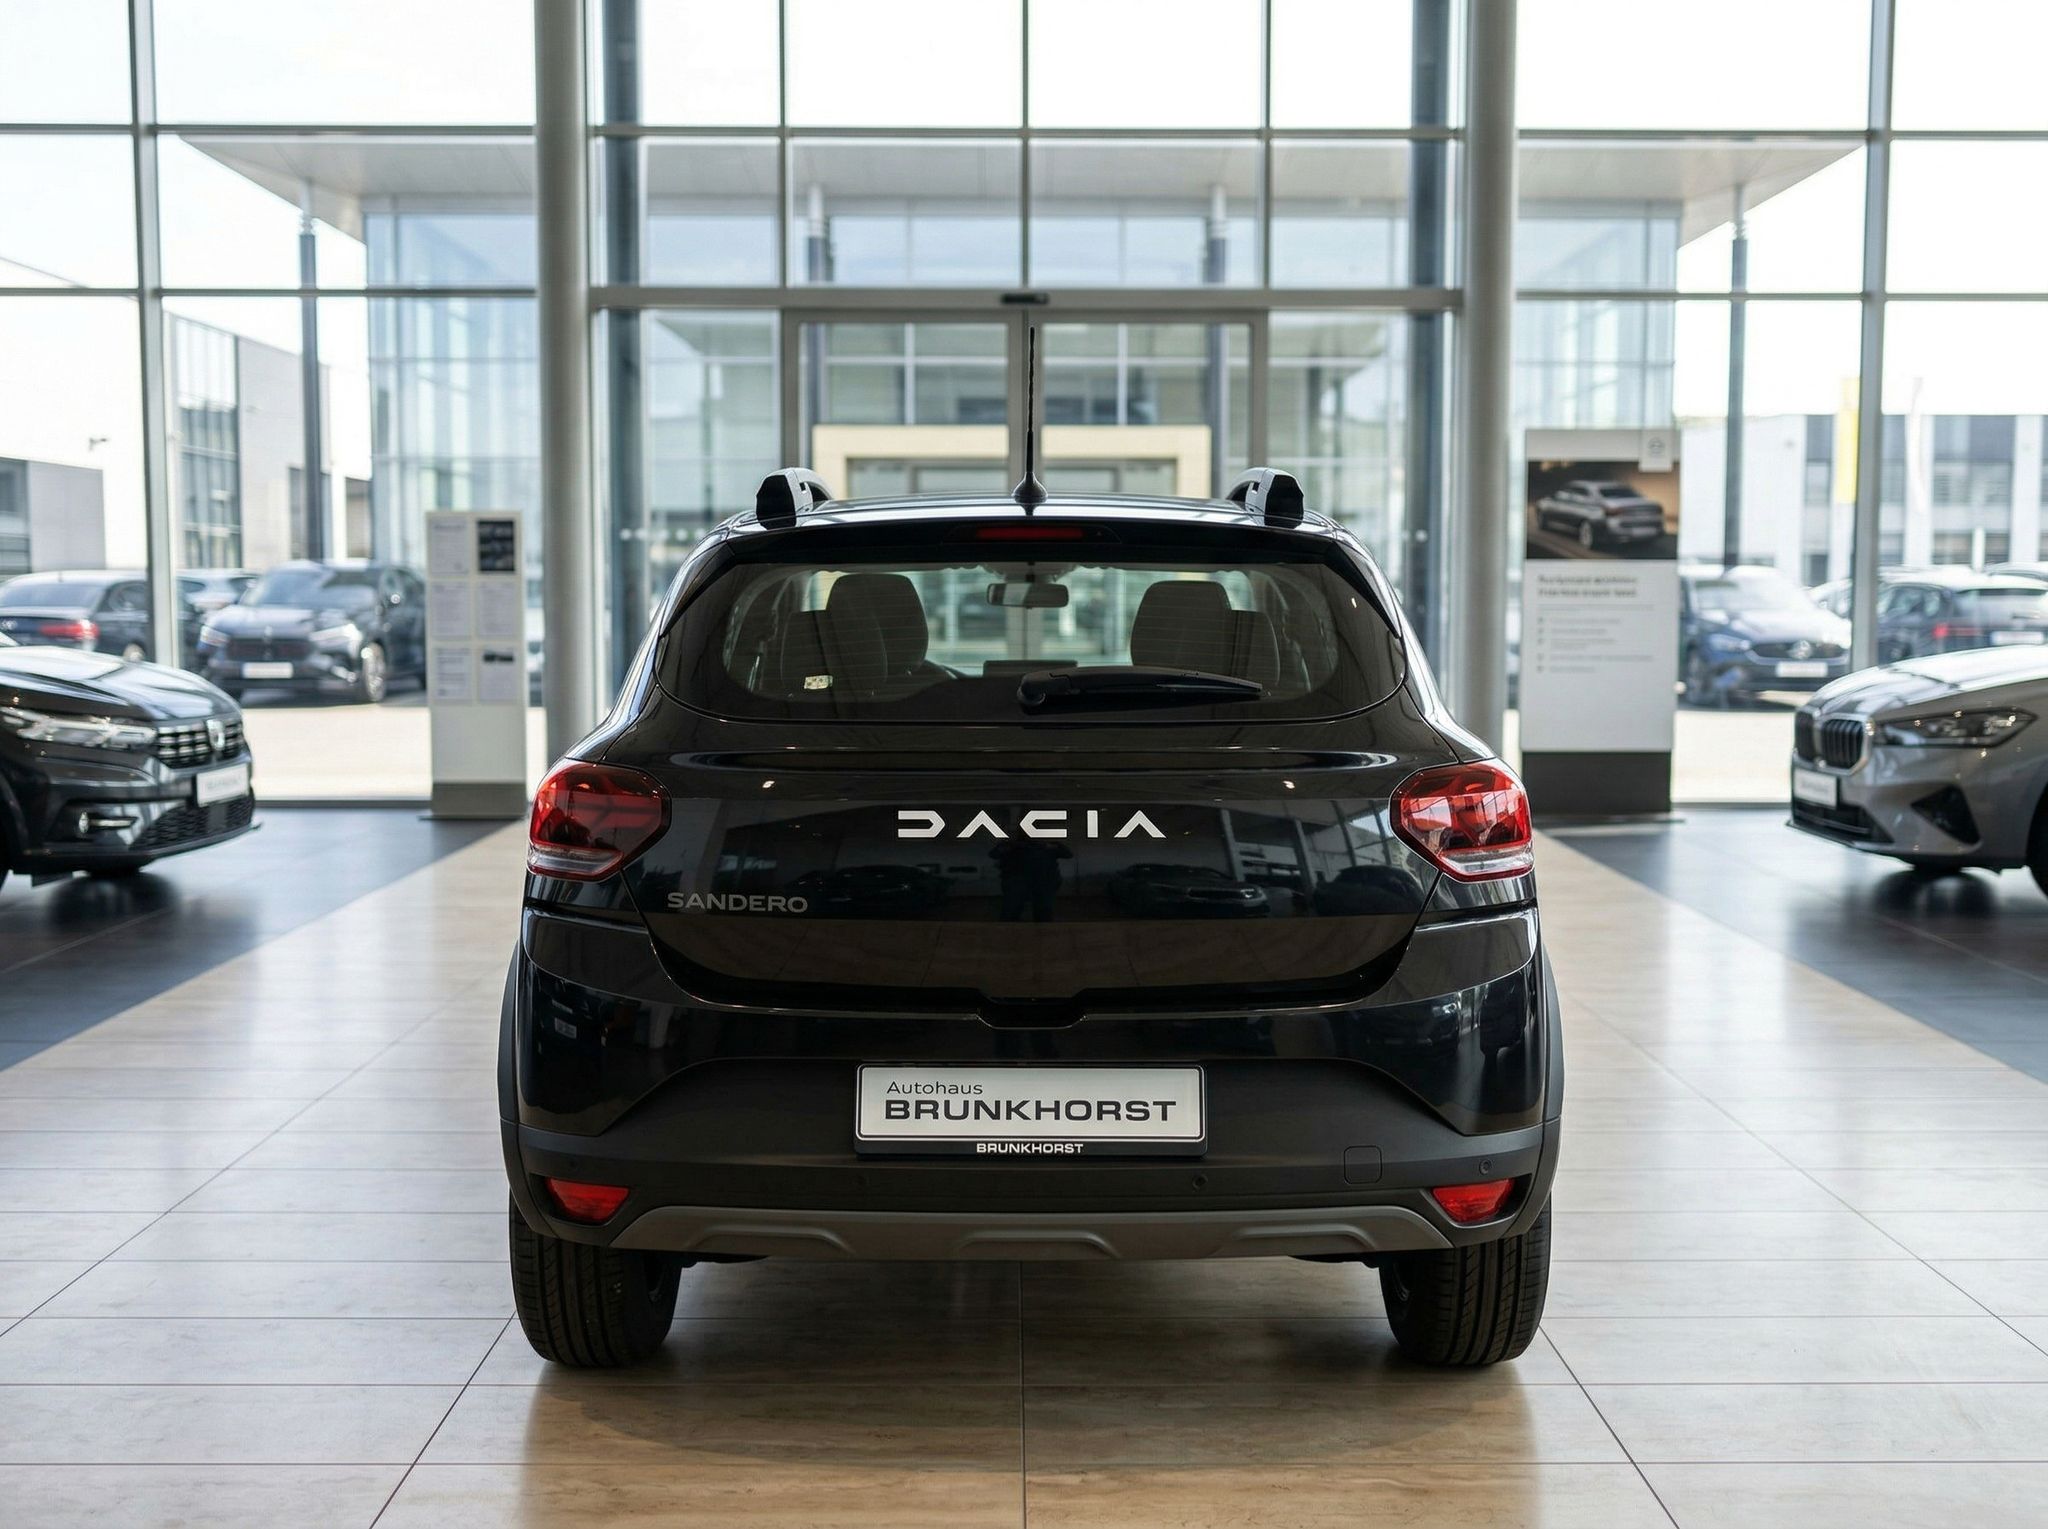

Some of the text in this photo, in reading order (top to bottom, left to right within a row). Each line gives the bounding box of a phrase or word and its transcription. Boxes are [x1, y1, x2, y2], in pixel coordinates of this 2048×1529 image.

[897, 810, 1167, 839] DACIA
[667, 892, 809, 913] SANDERO
[886, 1080, 984, 1095] Autohaus
[884, 1099, 1177, 1122] BRUNKHORST
[976, 1143, 1084, 1154] BRUNKHORST
